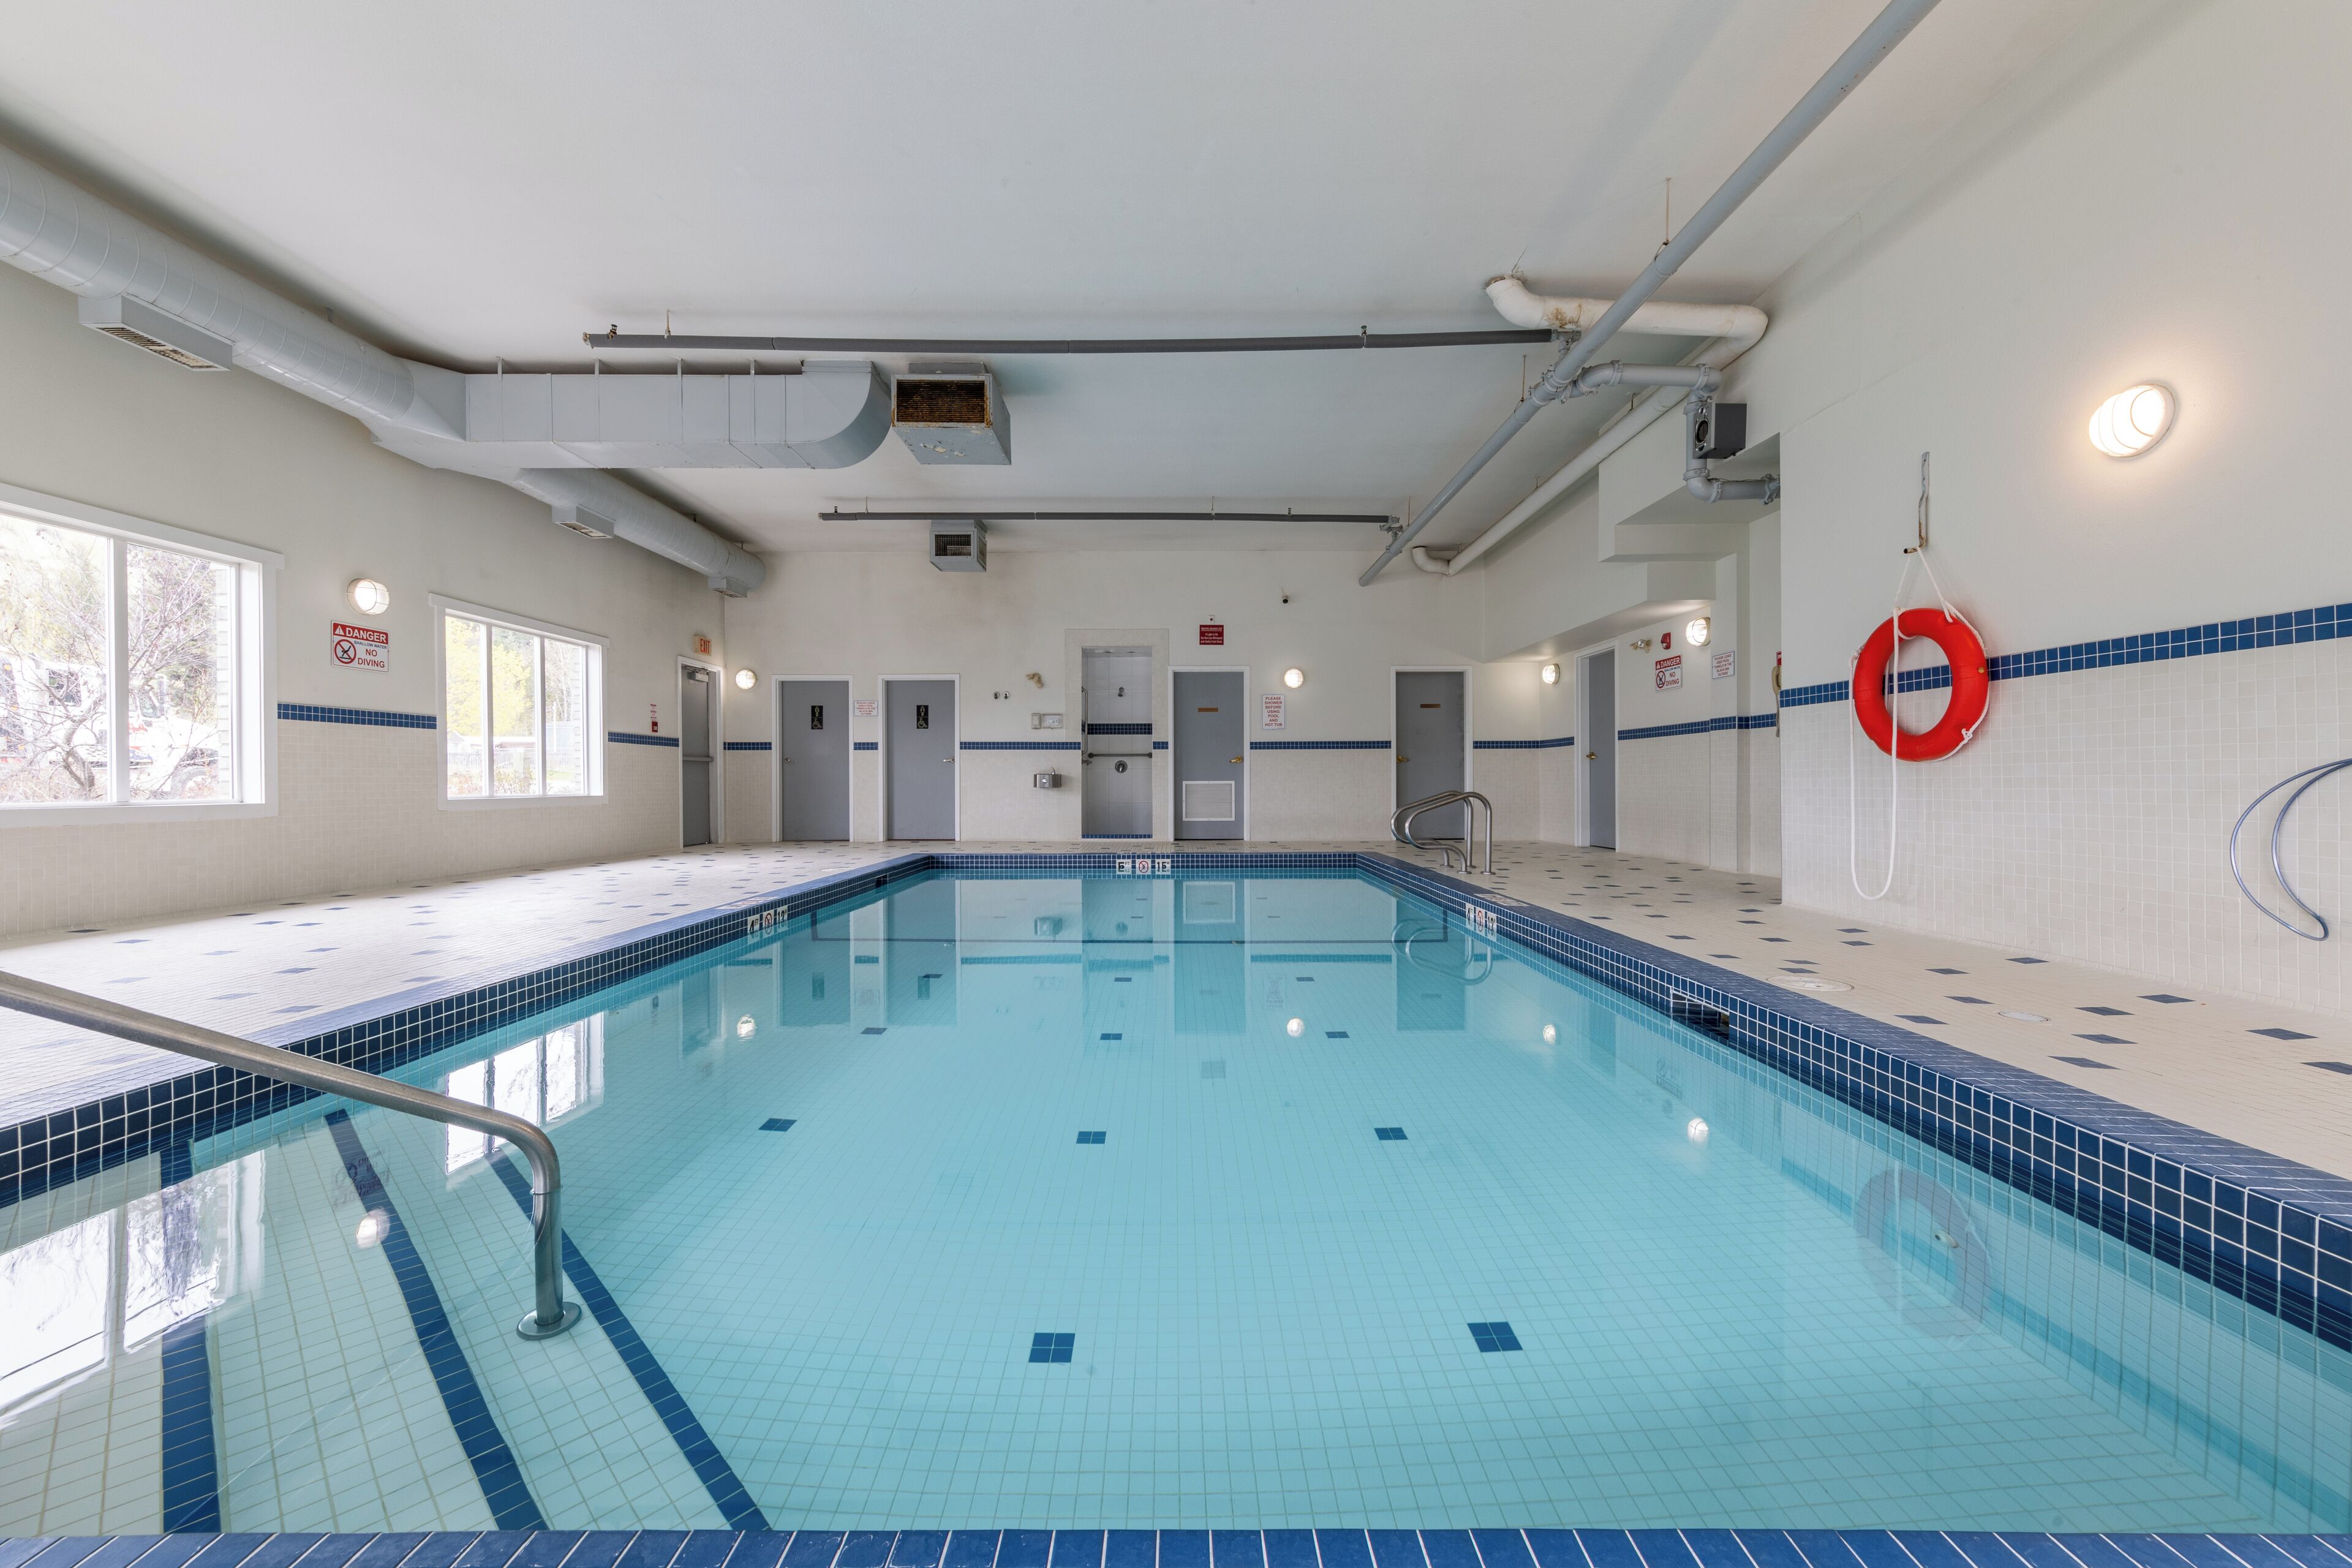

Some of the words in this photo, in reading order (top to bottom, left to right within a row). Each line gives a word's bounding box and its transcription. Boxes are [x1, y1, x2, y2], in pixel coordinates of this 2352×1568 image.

[346, 627, 386, 643] DANGER
[701, 639, 710, 654] EXIT
[358, 657, 385, 668] DIVING
[1660, 657, 1680, 668] DANGER
